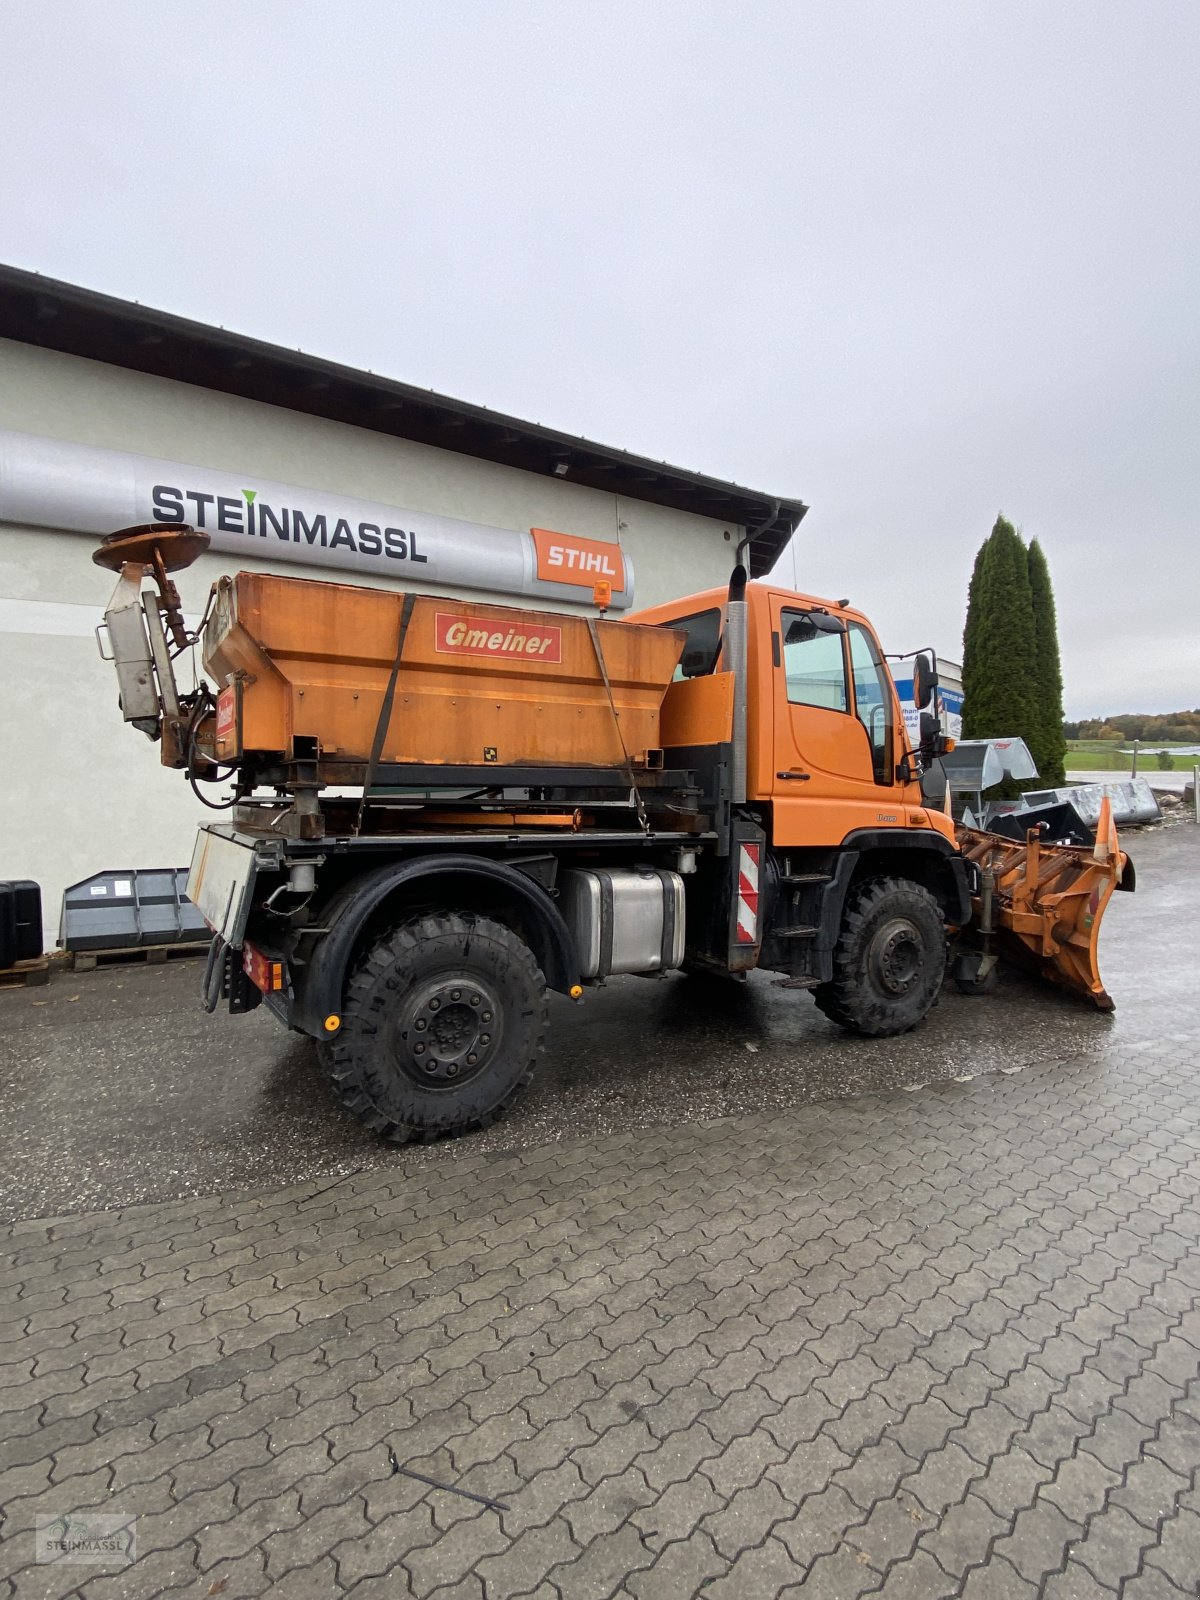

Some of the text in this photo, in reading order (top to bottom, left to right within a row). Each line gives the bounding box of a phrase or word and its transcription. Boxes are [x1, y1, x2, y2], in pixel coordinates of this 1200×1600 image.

[152, 485, 427, 562] STEINMASSL
[547, 545, 616, 576] STIHL
[445, 622, 552, 654] Gmeiner
